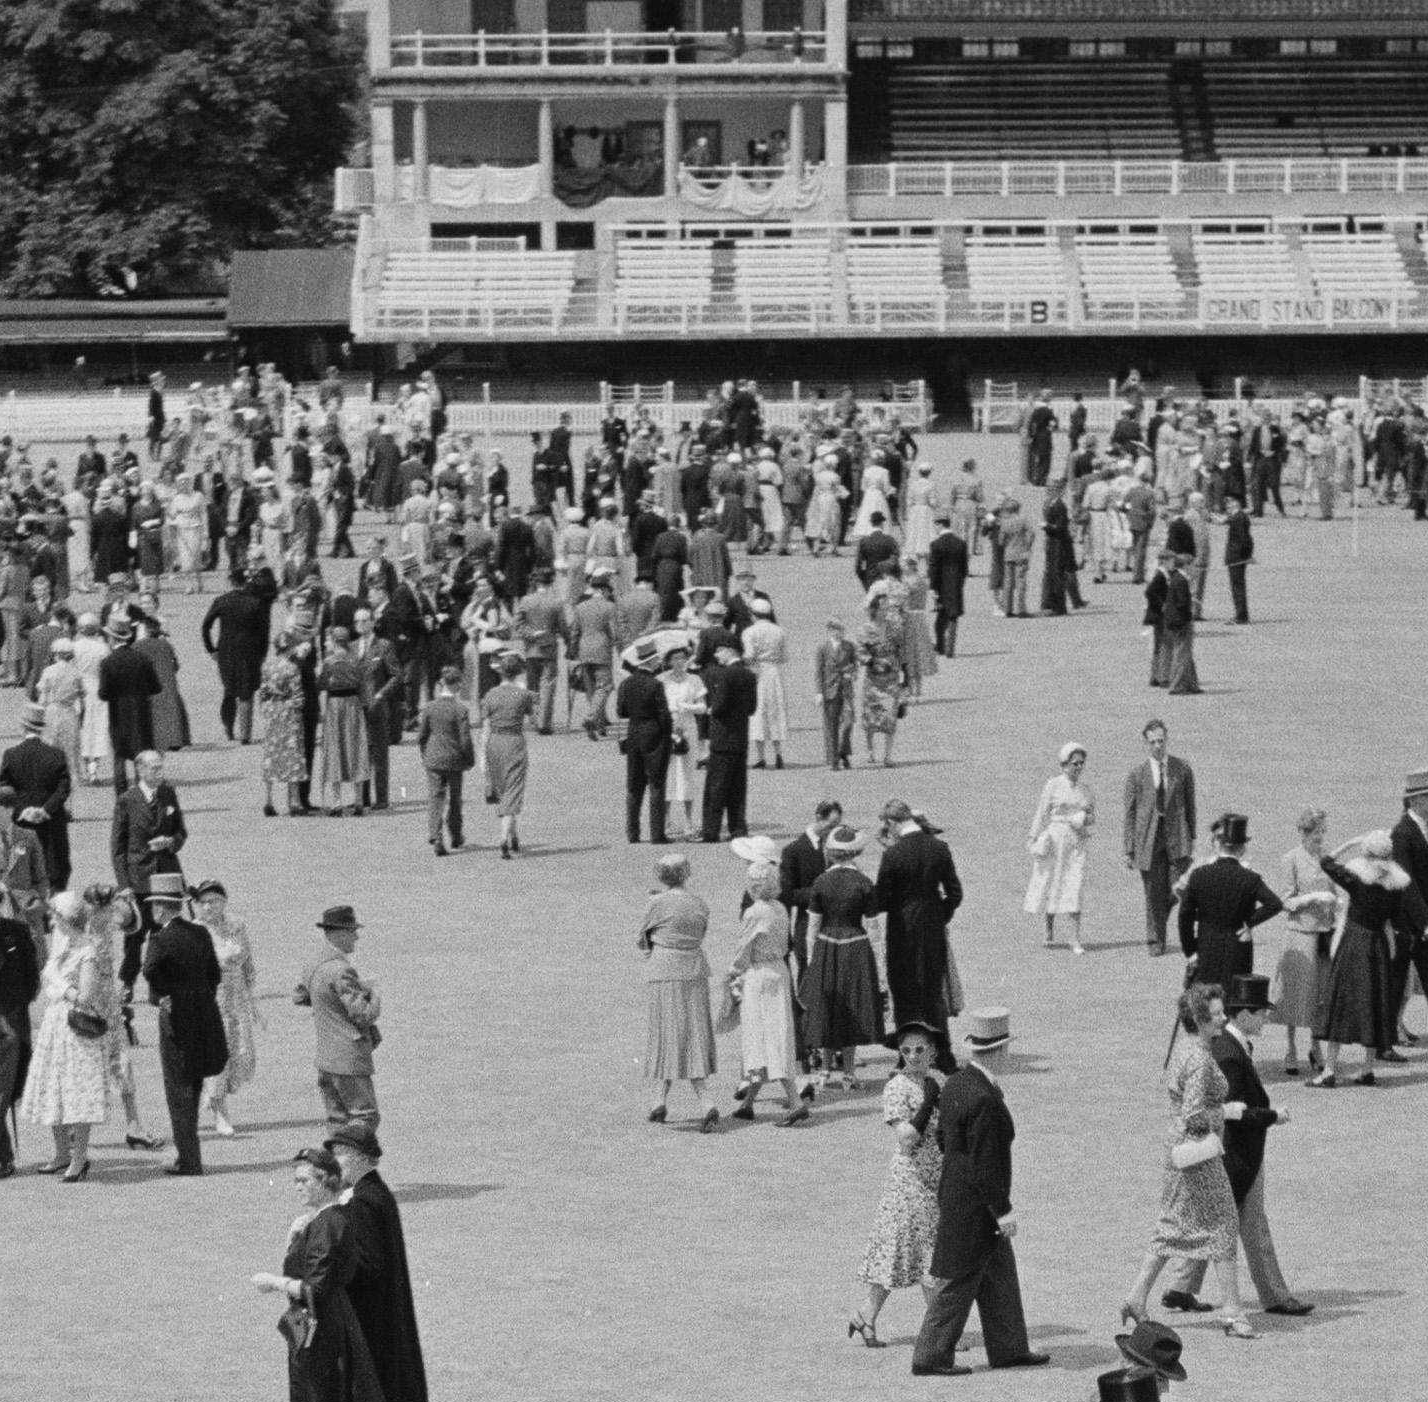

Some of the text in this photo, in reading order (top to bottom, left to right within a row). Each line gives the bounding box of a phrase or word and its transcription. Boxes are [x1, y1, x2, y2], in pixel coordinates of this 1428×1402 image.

[1030, 301, 1048, 324] B
[1206, 299, 1261, 321] GRAND
[1273, 299, 1323, 321] STAND
